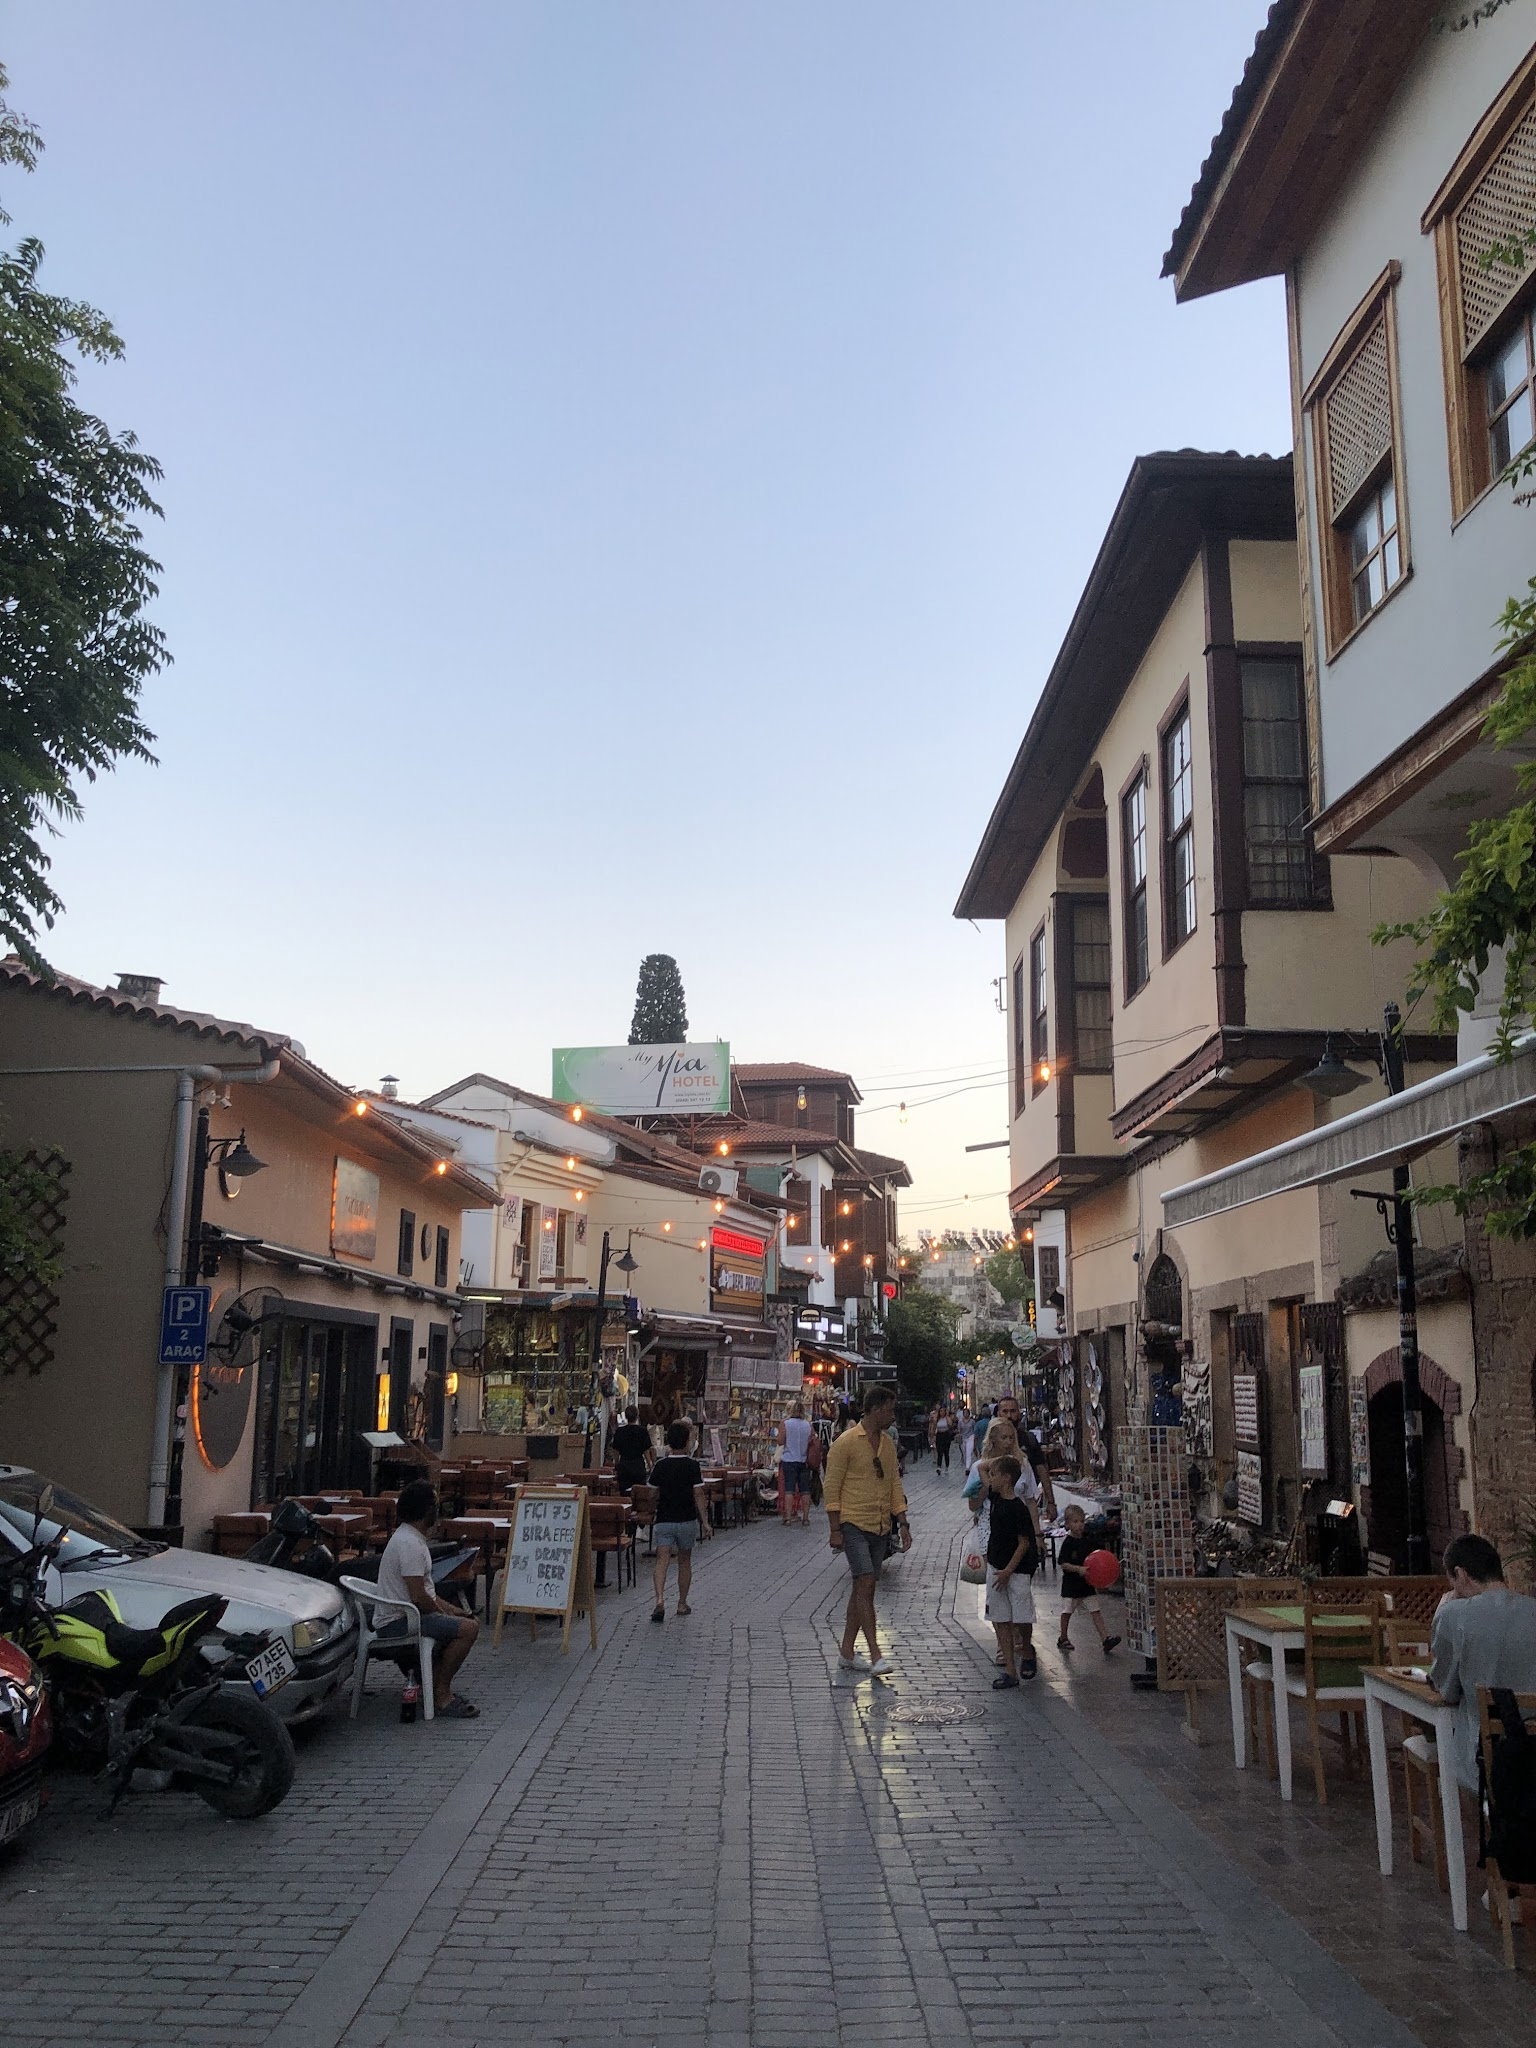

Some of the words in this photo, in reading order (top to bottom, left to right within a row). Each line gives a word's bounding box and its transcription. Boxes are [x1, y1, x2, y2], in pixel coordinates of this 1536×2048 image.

[628, 1051, 653, 1064] My
[640, 1050, 707, 1107] Mia
[673, 1076, 719, 1088] HOTEL
[176, 1296, 196, 1320] P
[180, 1329, 189, 1340] 2
[163, 1345, 202, 1360] ARAÇ
[552, 1505, 572, 1520] 75
[534, 1547, 572, 1564] DRAFT
[537, 1563, 566, 1581] BEER
[249, 1659, 263, 1677] 07
[263, 1642, 286, 1668] AEE
[264, 1661, 286, 1685] 735
